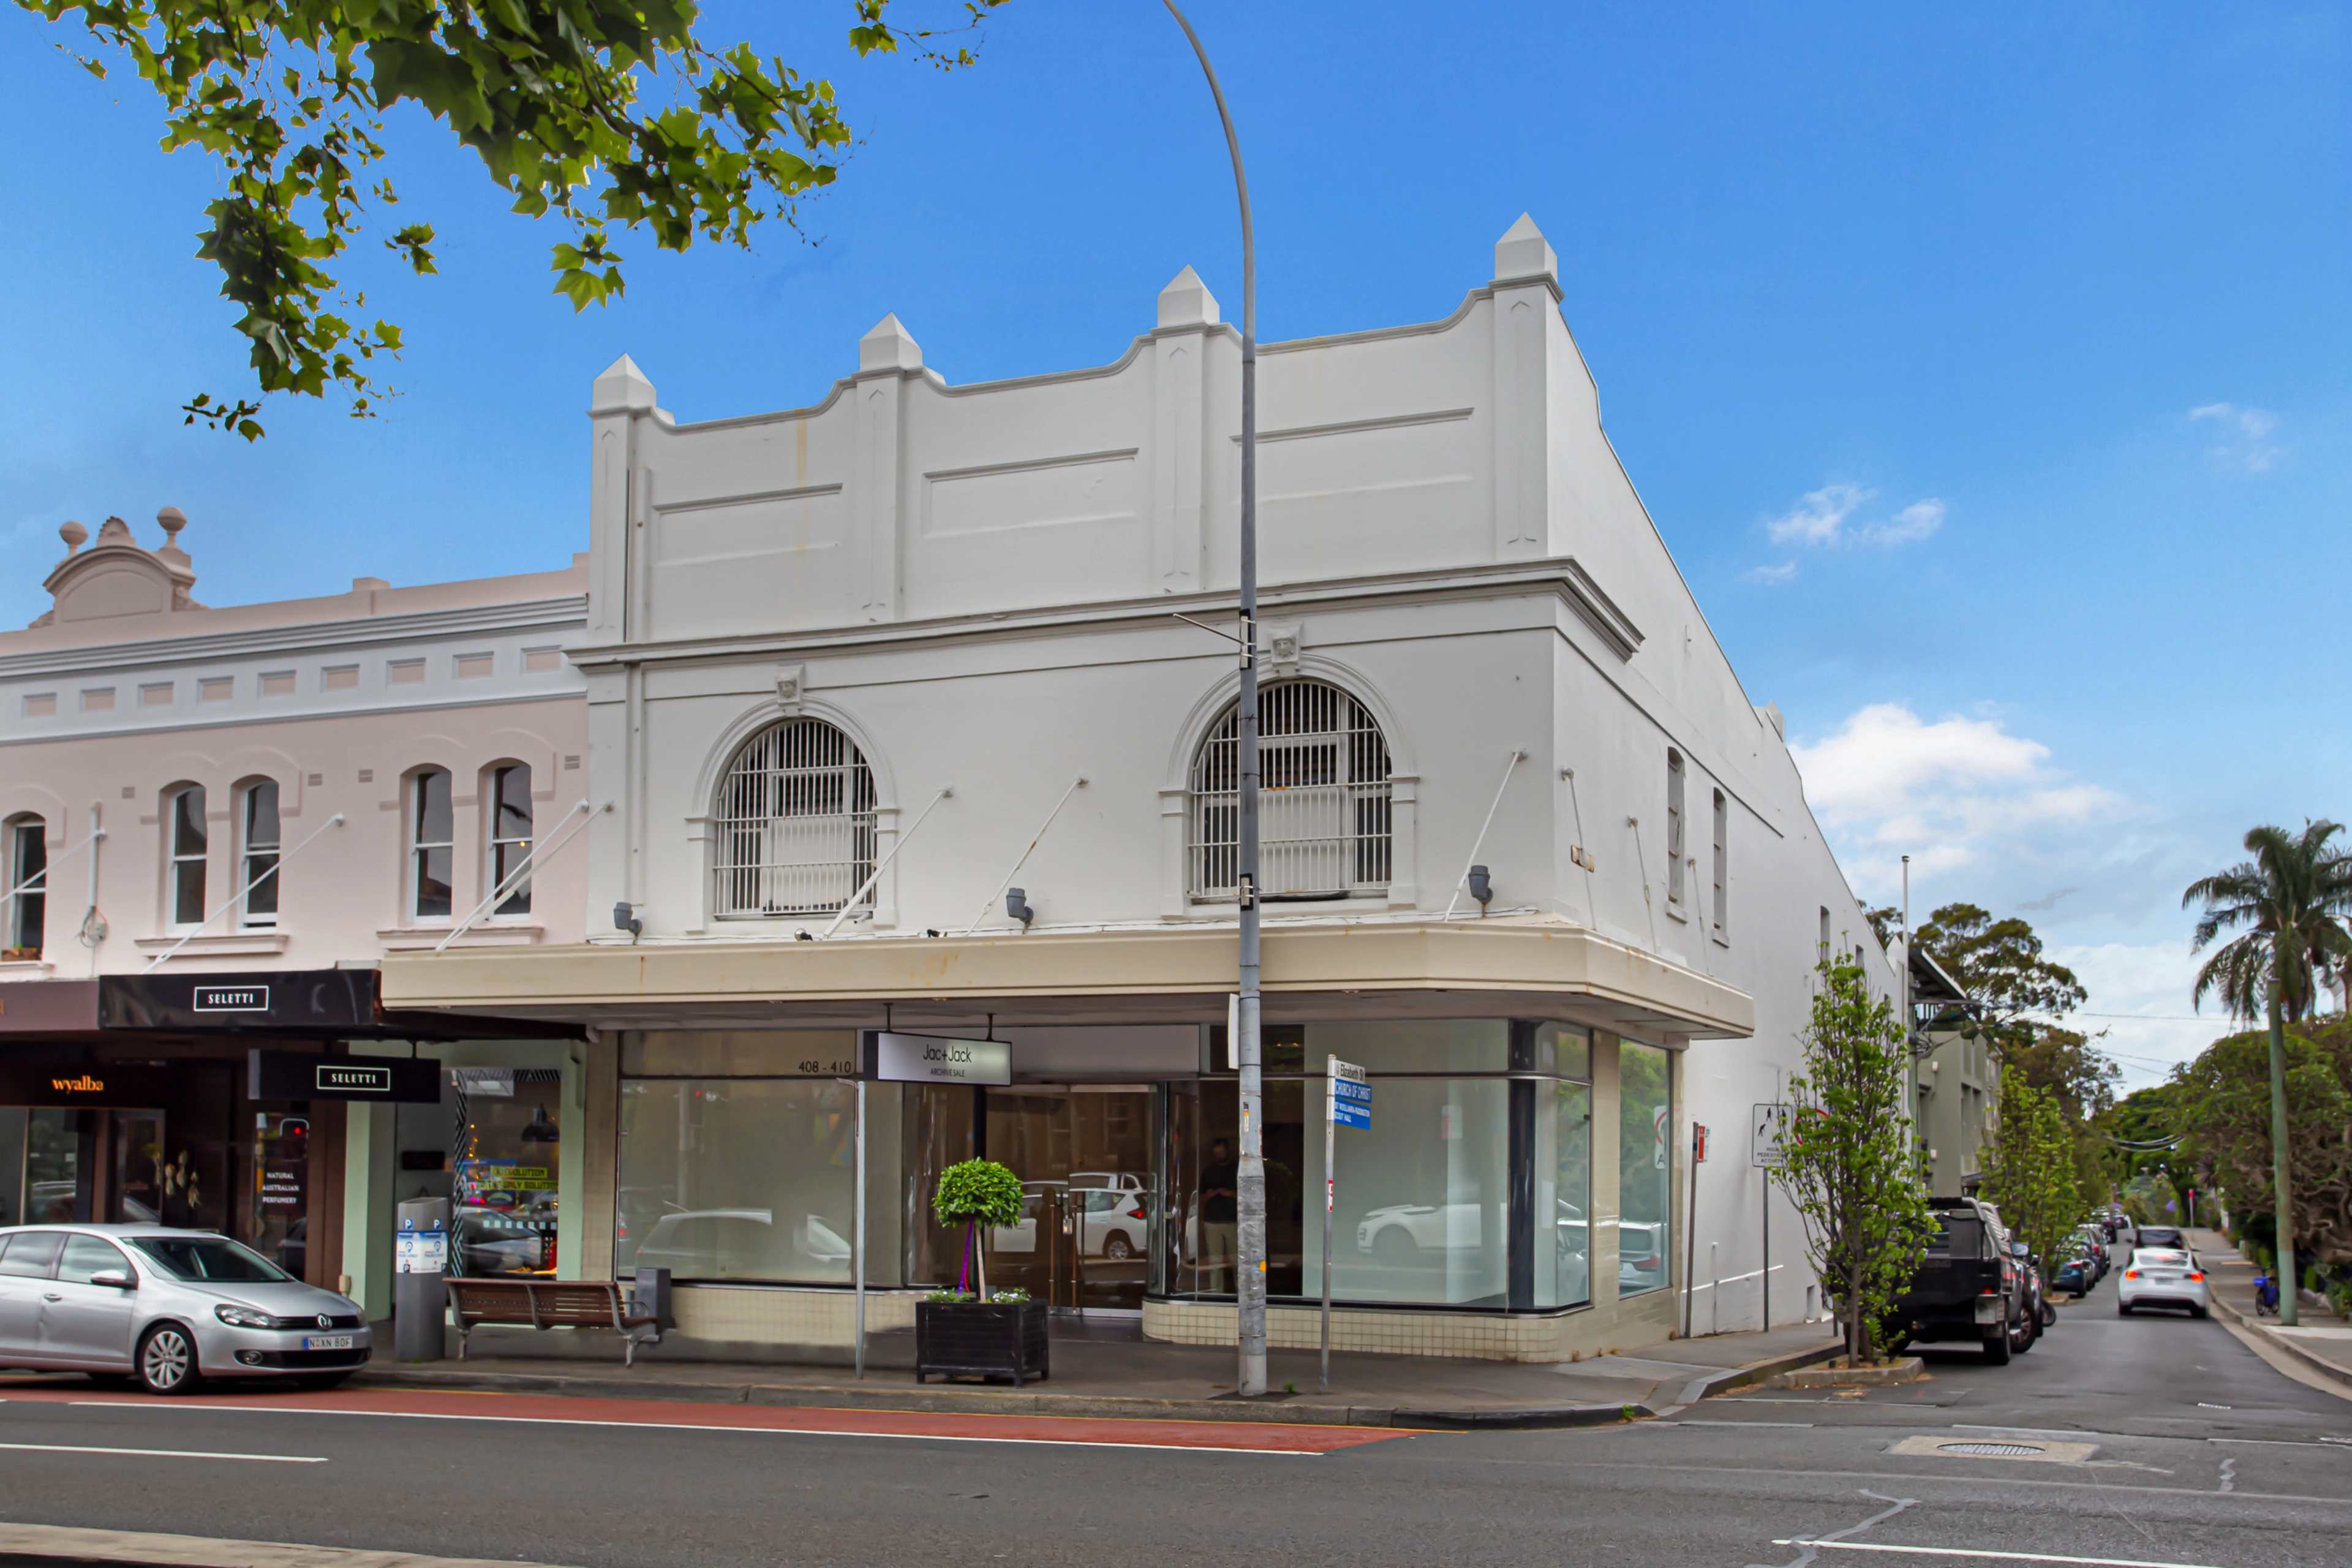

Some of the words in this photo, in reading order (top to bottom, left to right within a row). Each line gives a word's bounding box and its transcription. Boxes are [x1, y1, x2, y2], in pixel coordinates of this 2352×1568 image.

[208, 993, 254, 1004] SELETTI
[923, 1044, 972, 1063] Jac+Jack
[798, 1061, 819, 1072] 408
[830, 1061, 851, 1073] 410
[1340, 1064, 1359, 1079] Elizabeth
[1359, 1068, 1364, 1081] St
[331, 1073, 376, 1084] SELETTI
[952, 1069, 965, 1077] SALE
[52, 1075, 104, 1094] wyalba
[1336, 1081, 1352, 1097] CHURCH
[1352, 1085, 1357, 1098] OF
[1357, 1085, 1371, 1101] CHRIST
[405, 1219, 412, 1229] P
[434, 1219, 440, 1229] P
